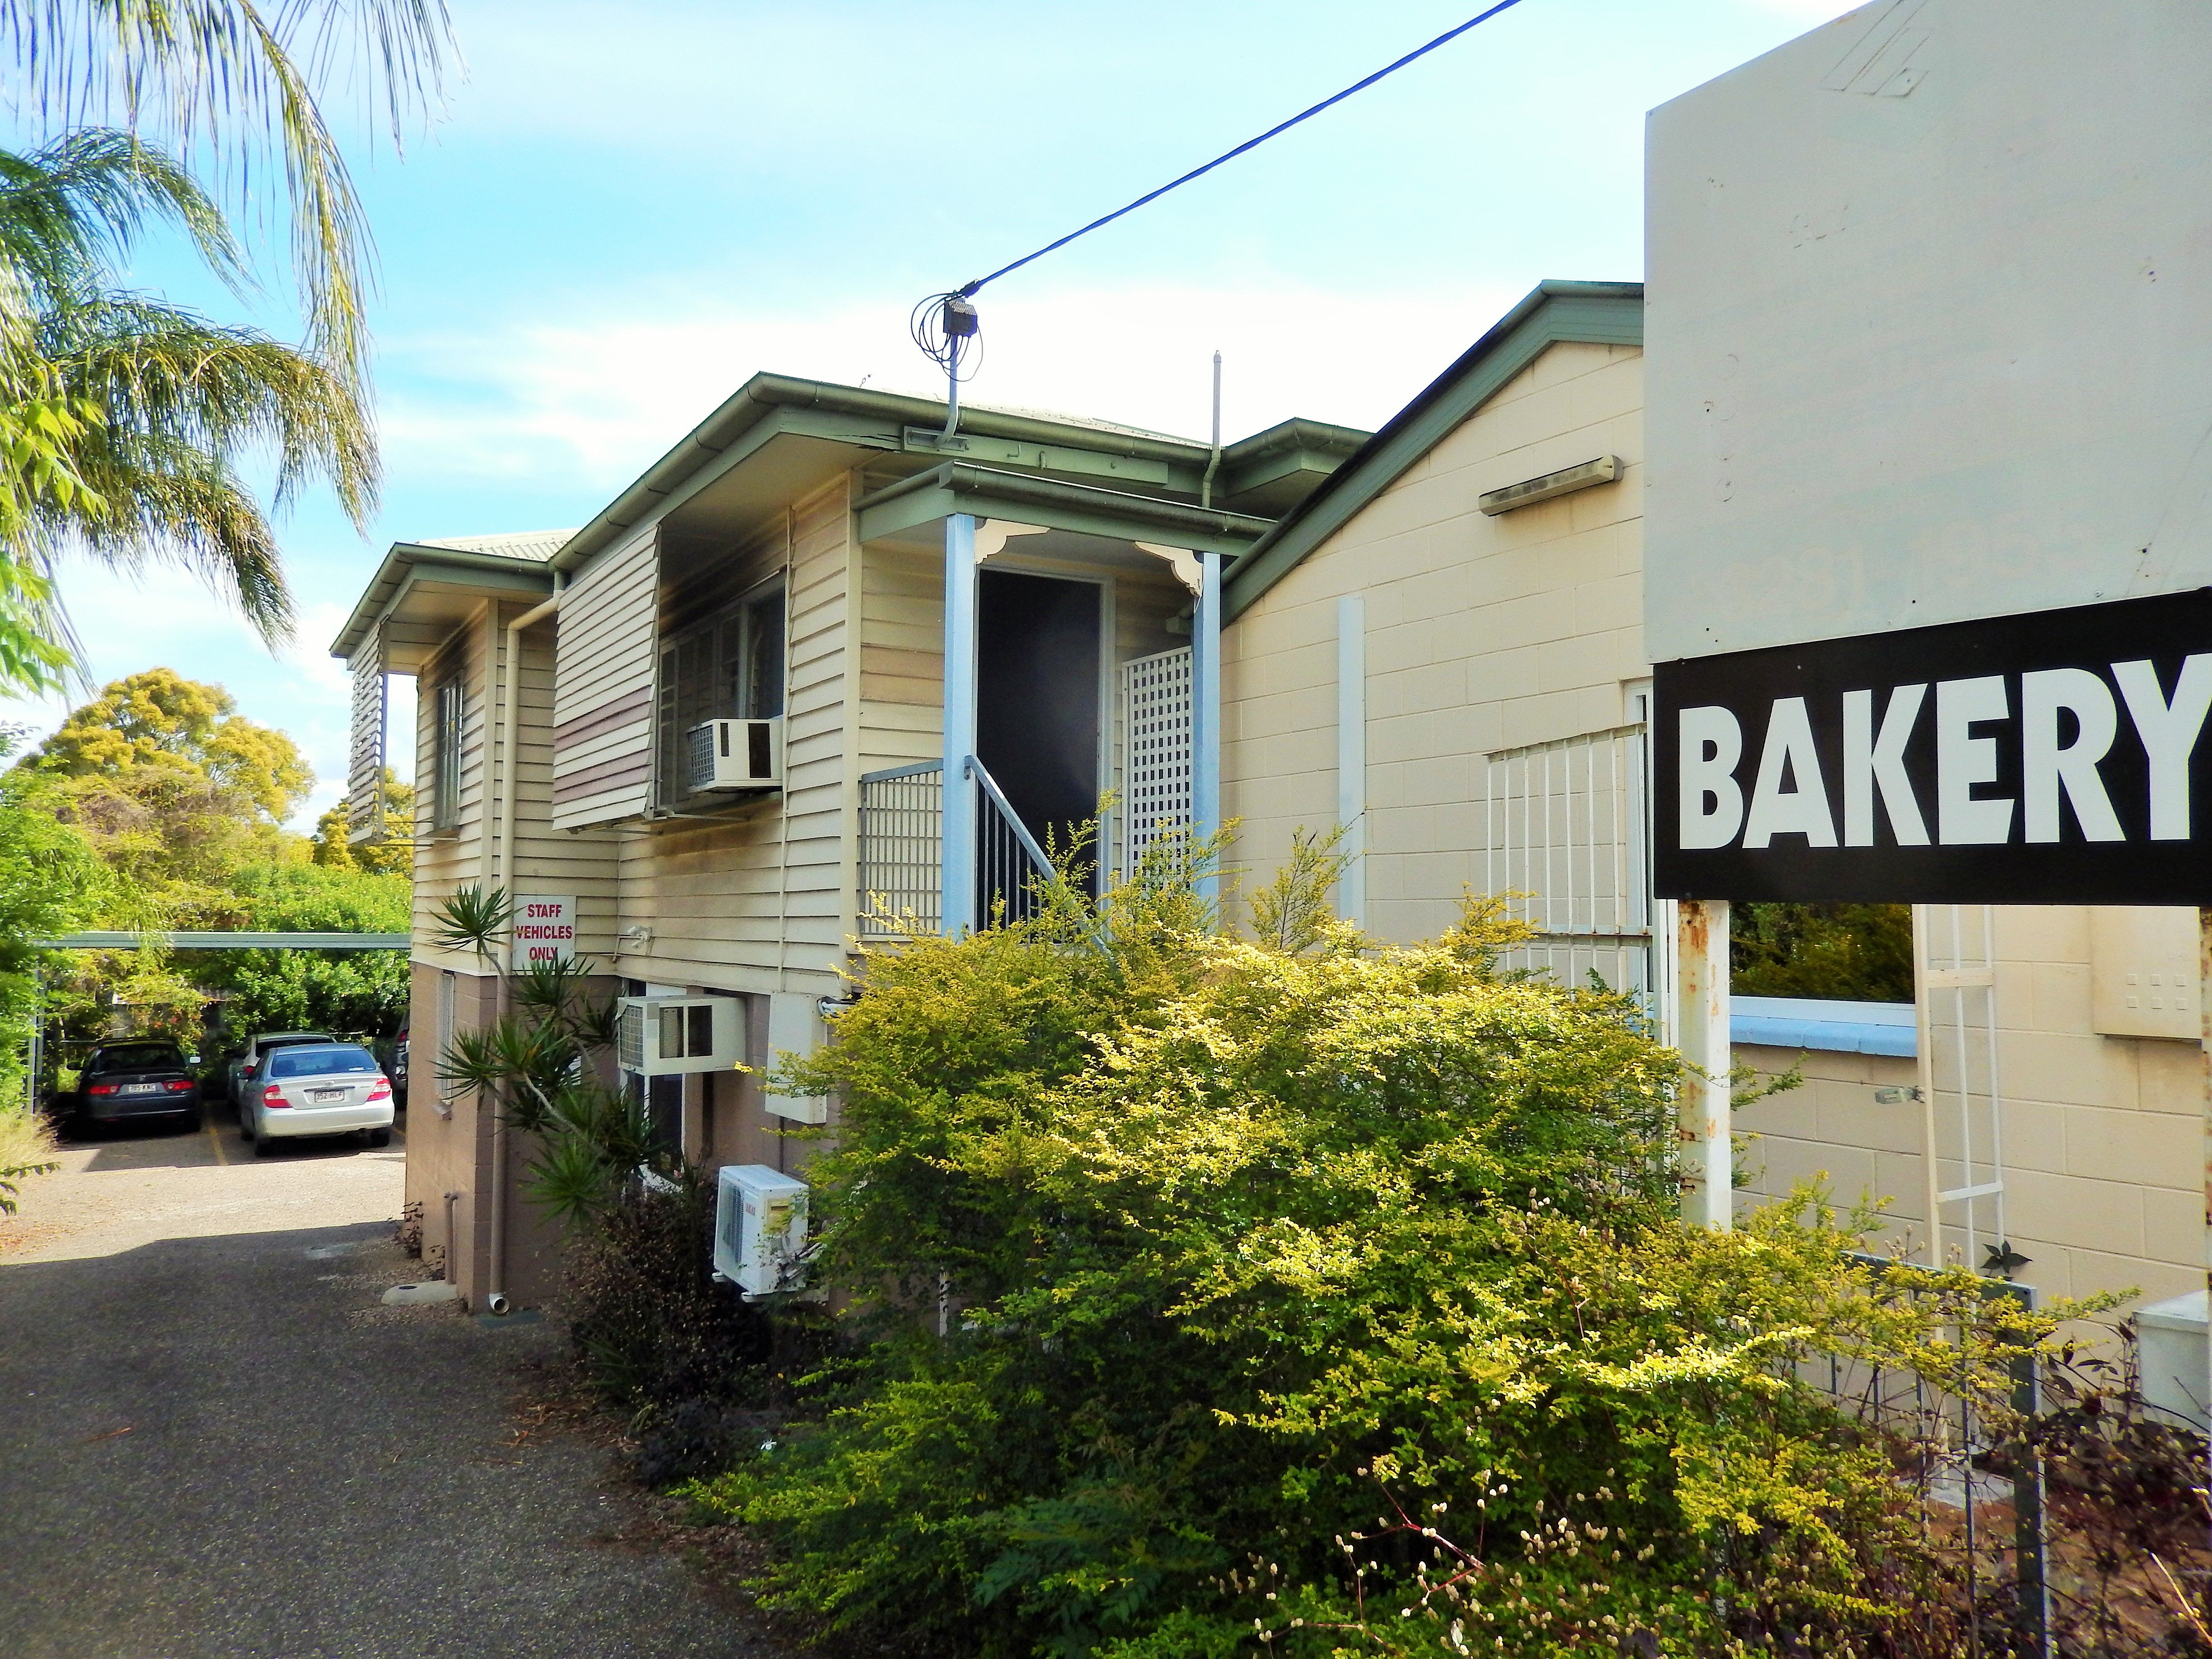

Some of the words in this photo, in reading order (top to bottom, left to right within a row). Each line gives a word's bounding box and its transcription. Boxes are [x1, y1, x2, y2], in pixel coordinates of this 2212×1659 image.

[1679, 653, 2212, 850] BAKERY
[528, 904, 562, 918] STAFF
[516, 925, 572, 939] VEHICLES
[529, 947, 558, 961] ONLY
